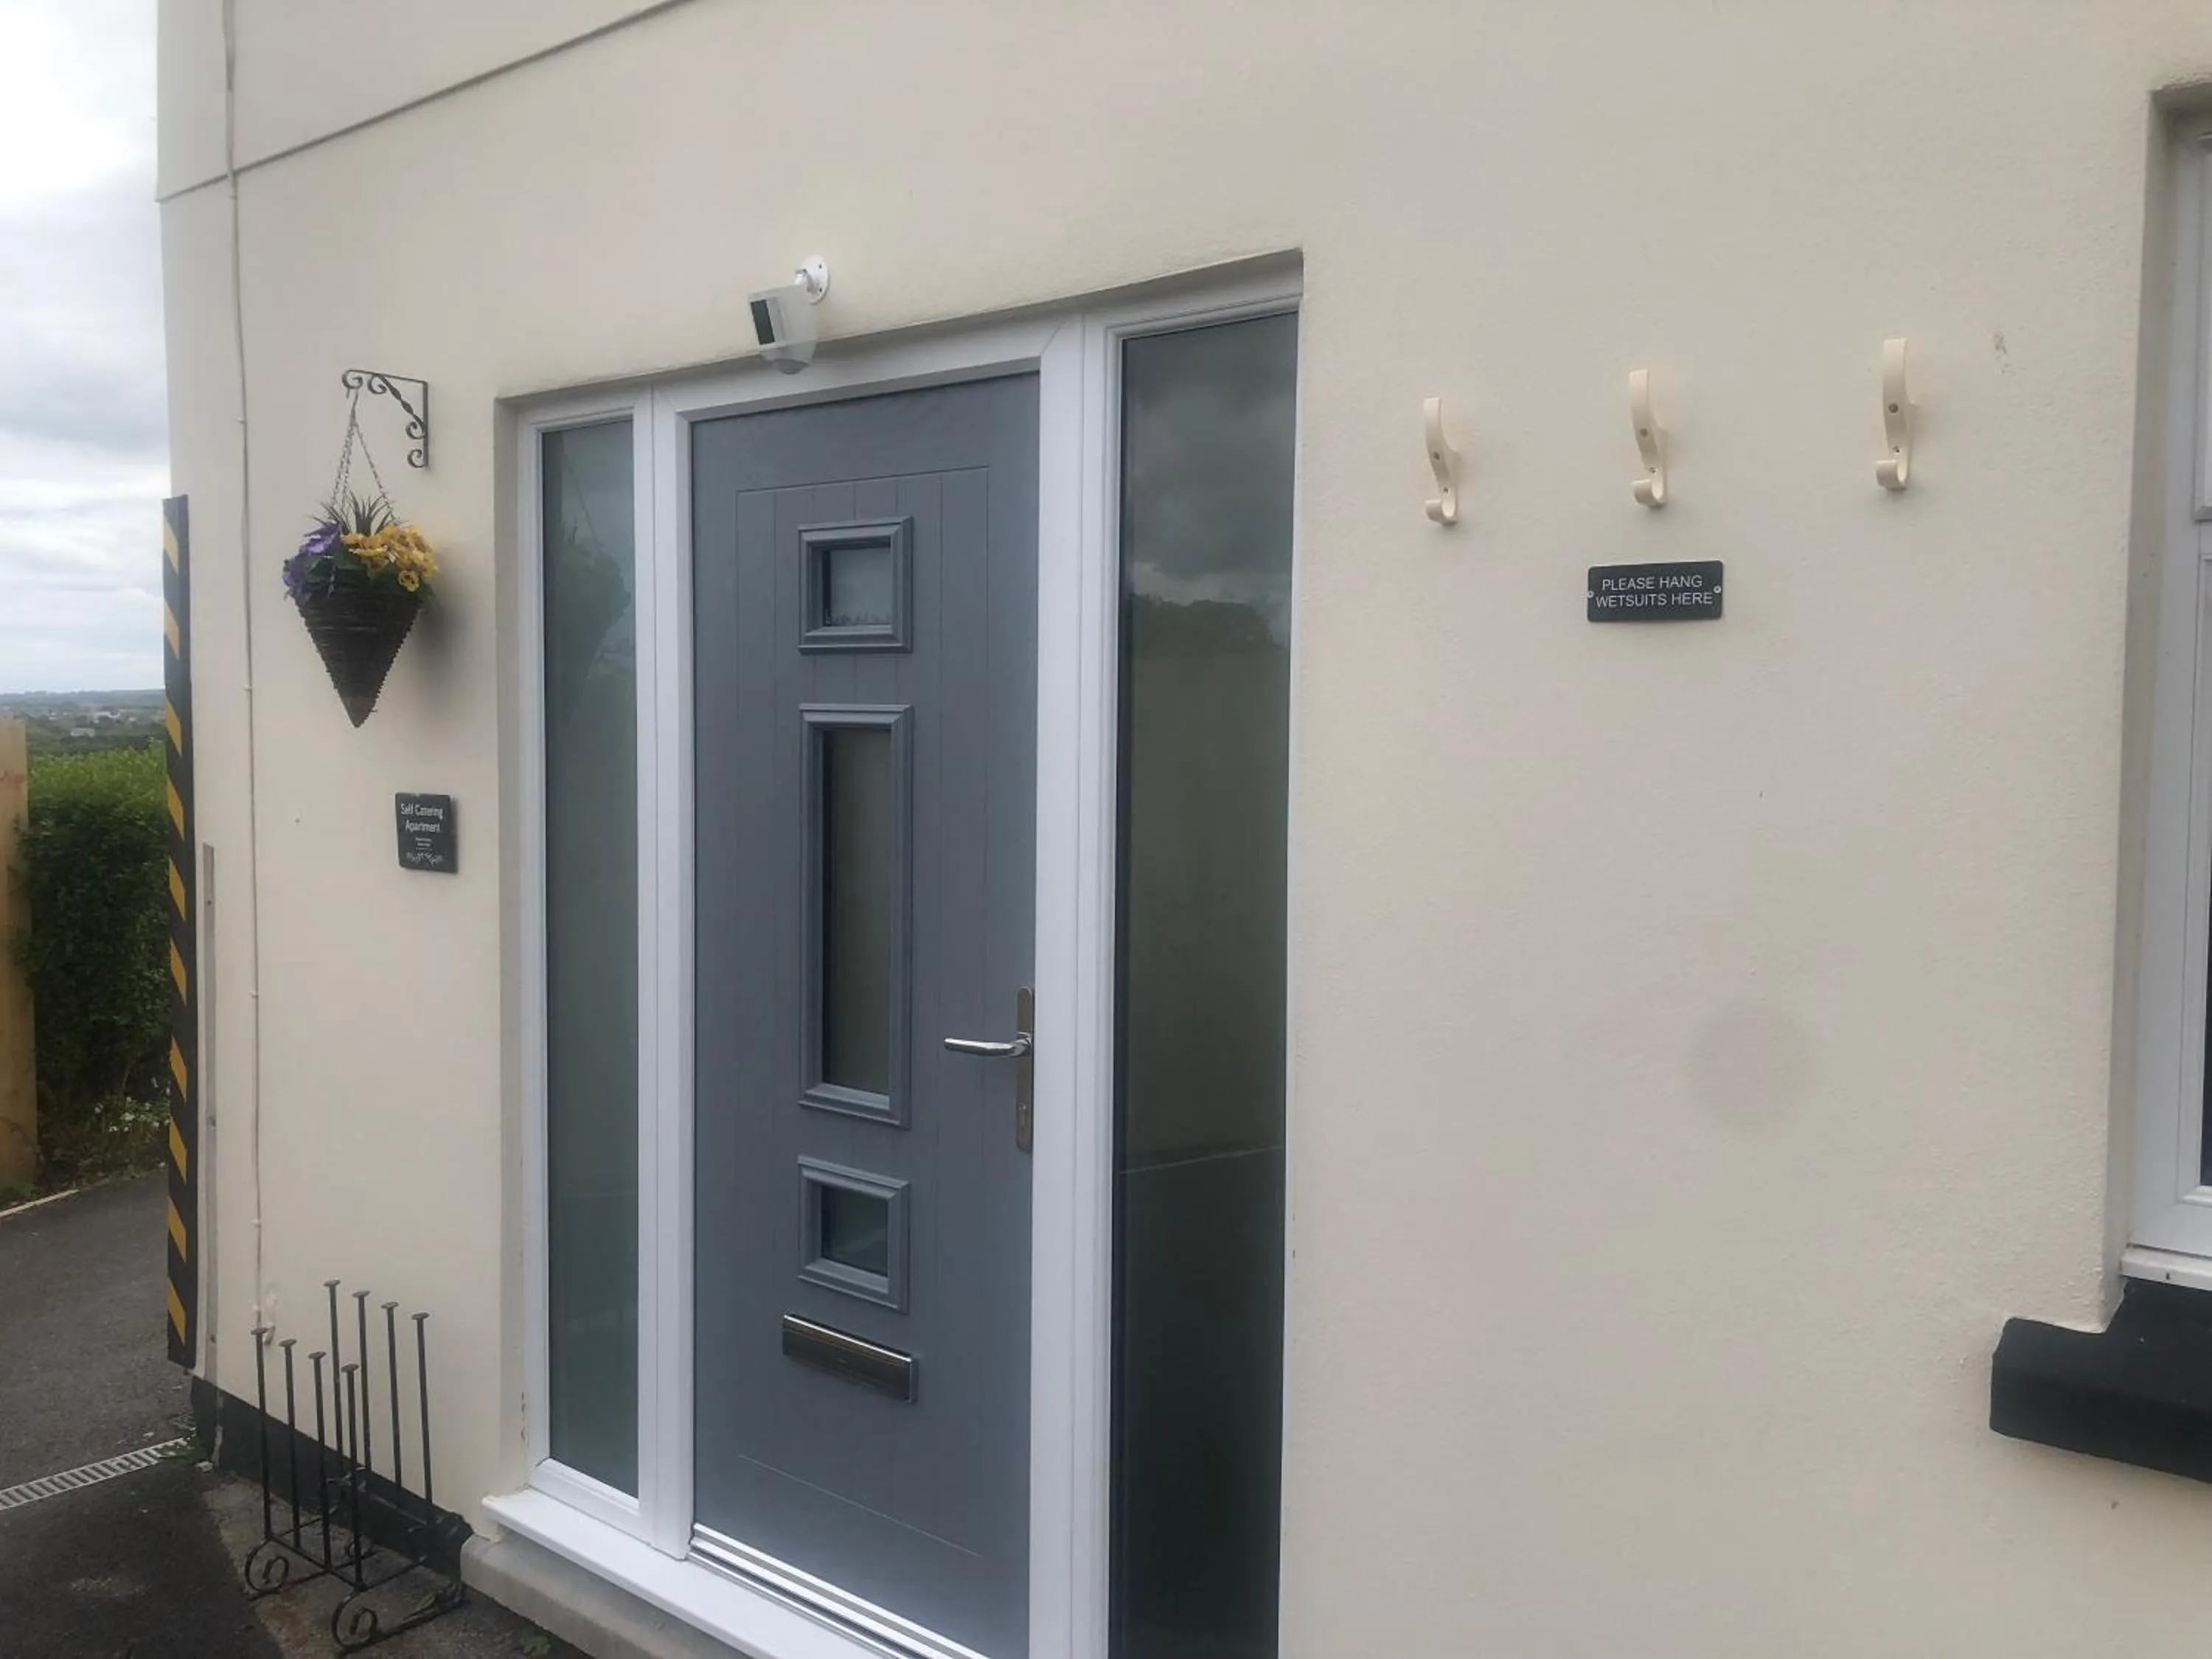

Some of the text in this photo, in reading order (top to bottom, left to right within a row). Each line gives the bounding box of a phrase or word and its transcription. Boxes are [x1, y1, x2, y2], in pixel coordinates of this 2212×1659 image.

[1601, 574, 1703, 591] PLEASE HANG
[1595, 592, 1714, 608] WETSUITS HERE
[405, 819, 440, 833] Apartment
